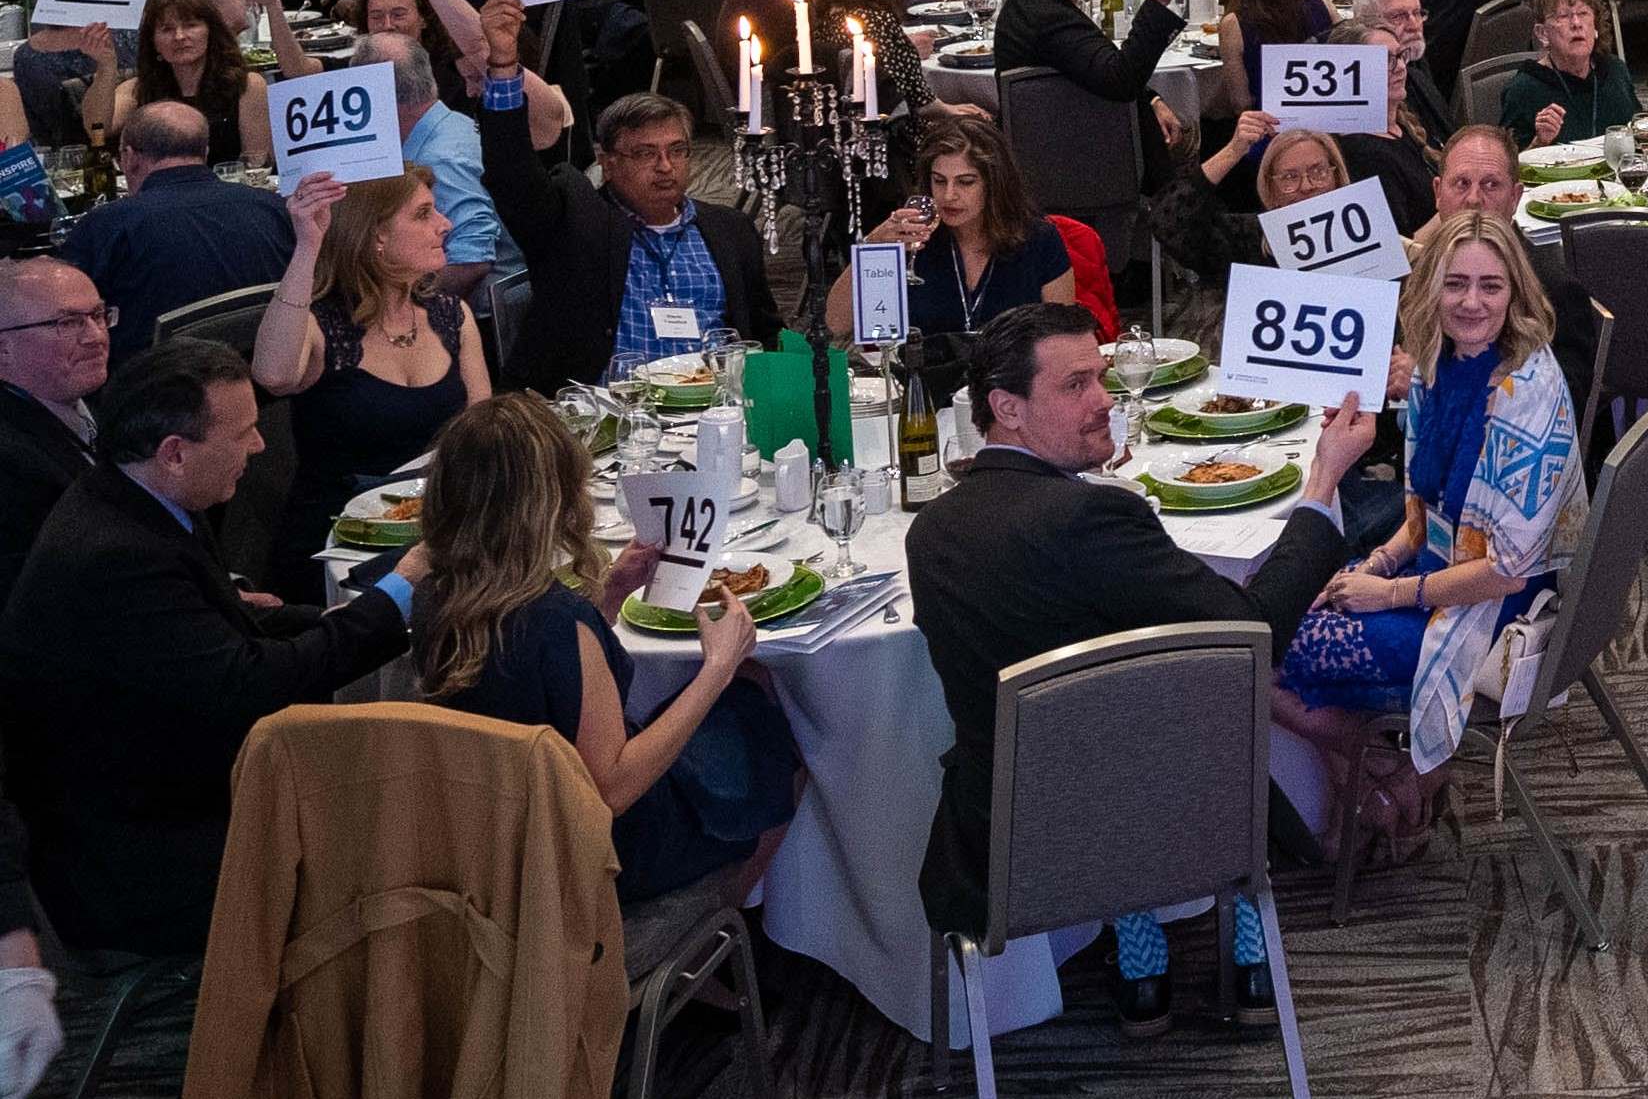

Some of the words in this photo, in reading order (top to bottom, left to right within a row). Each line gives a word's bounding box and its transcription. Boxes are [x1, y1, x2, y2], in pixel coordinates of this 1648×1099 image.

[1284, 60, 1360, 96] 531
[286, 87, 371, 142] 649
[0, 157, 34, 179] NSPIRE
[1287, 203, 1371, 260] 570
[864, 268, 894, 278] Table
[875, 301, 887, 313] 4
[1252, 300, 1364, 360] 859
[649, 497, 715, 552] 742
